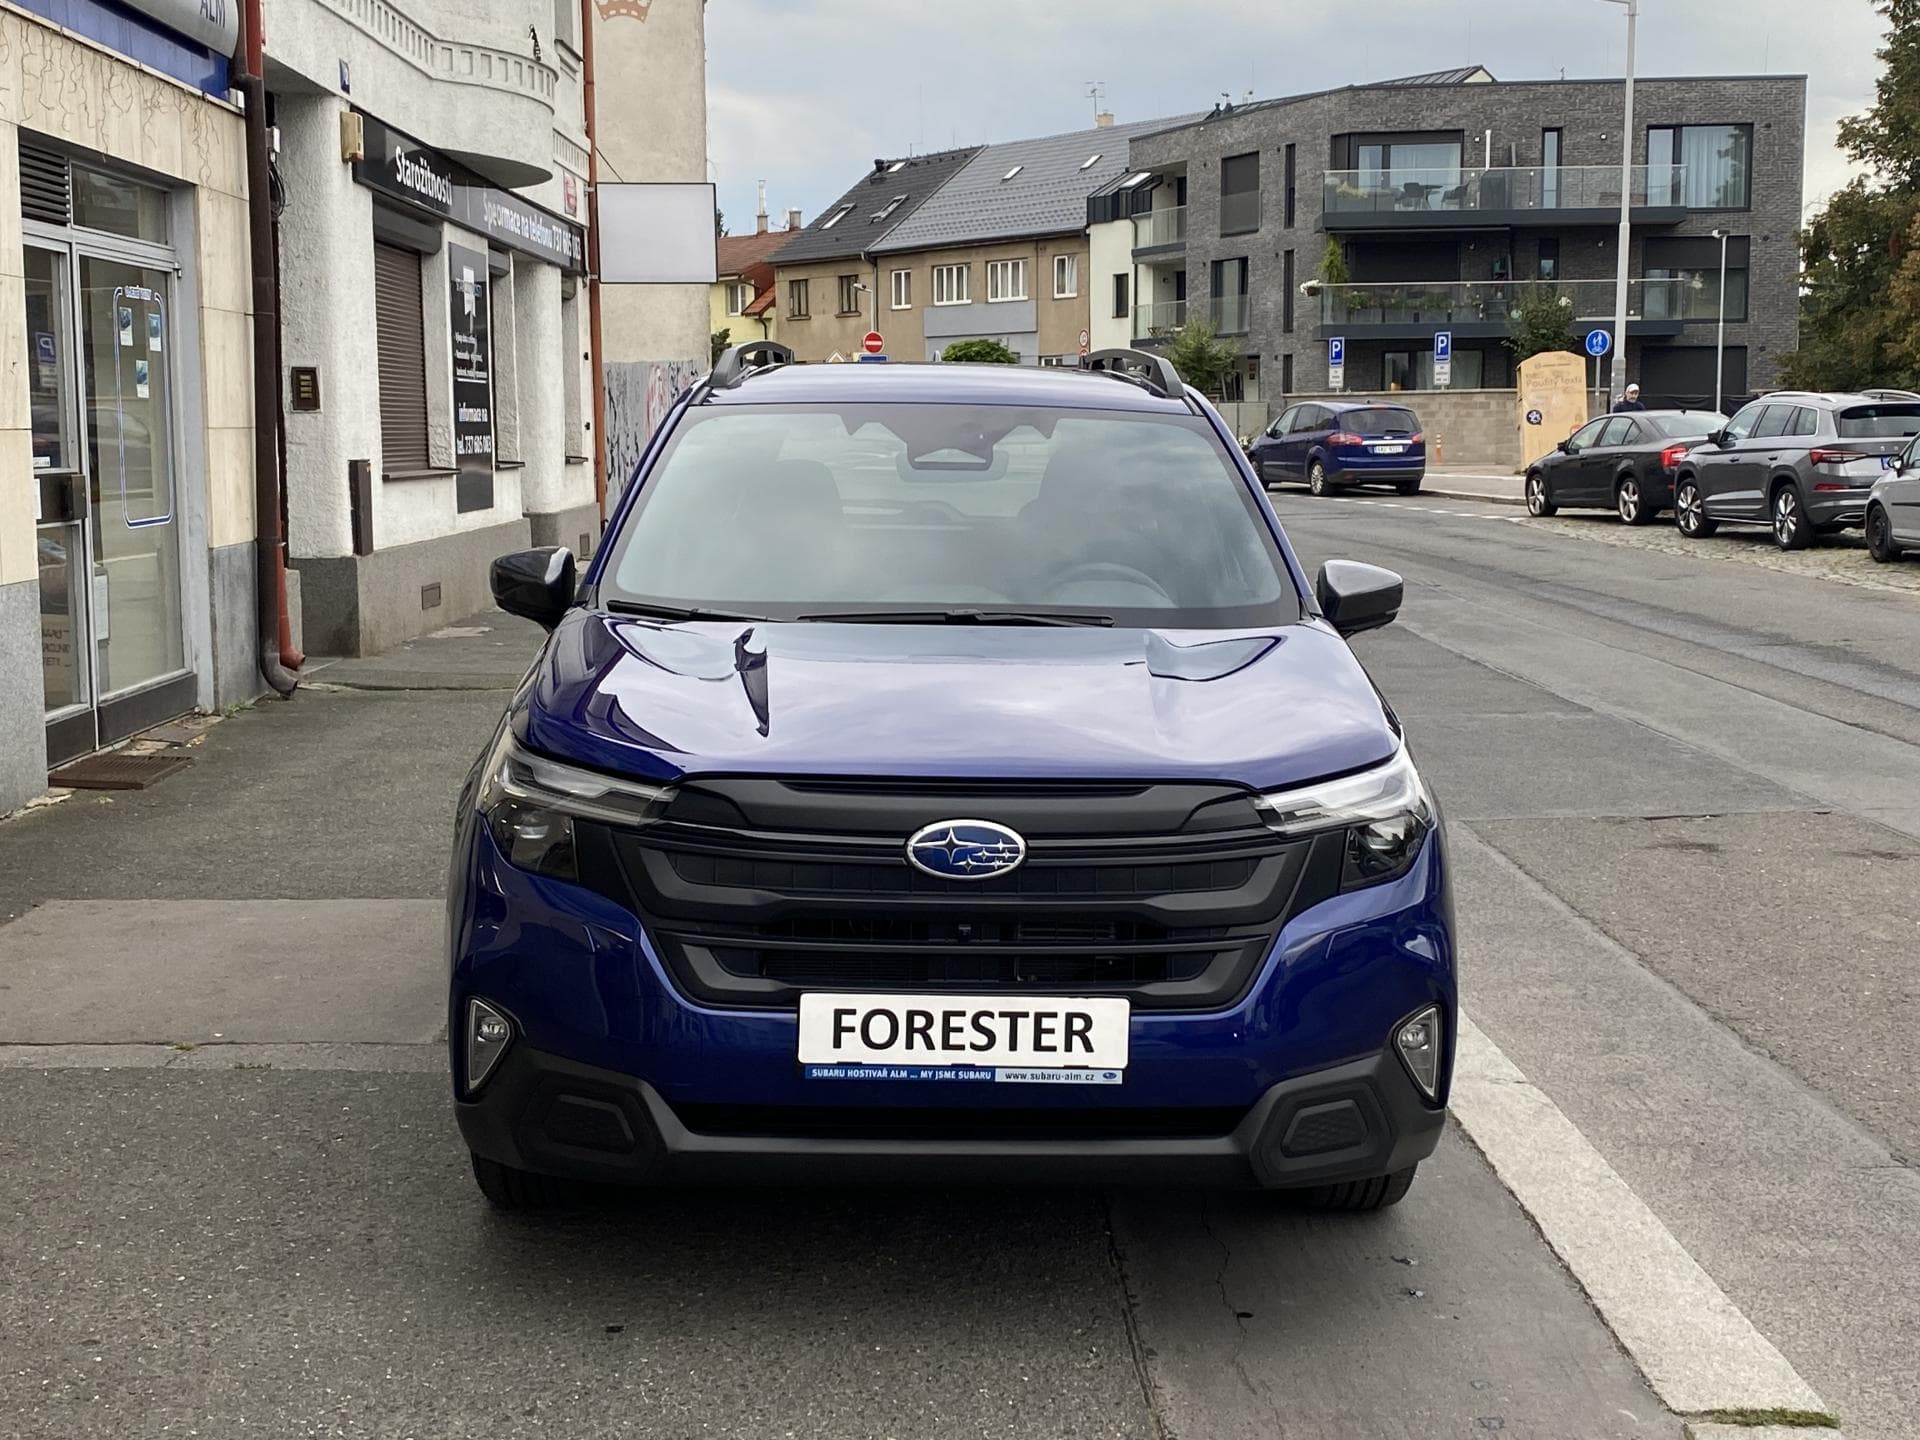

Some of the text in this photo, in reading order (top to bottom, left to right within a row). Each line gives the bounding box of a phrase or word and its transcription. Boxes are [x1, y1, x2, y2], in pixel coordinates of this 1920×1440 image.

[395, 145, 453, 206] Starožitnosti
[1332, 340, 1341, 358] P
[1437, 335, 1447, 354] P
[832, 1008, 1095, 1053] FORESTER
[811, 1068, 845, 1077] SUBARU
[847, 1067, 888, 1078] HOSTIVAŘ
[890, 1069, 908, 1078] ALM
[920, 1070, 933, 1079] MY
[935, 1070, 956, 1080] JSME
[958, 1071, 991, 1080] SUBARU
[1005, 1071, 1095, 1081] www.subaru-alm.cz
